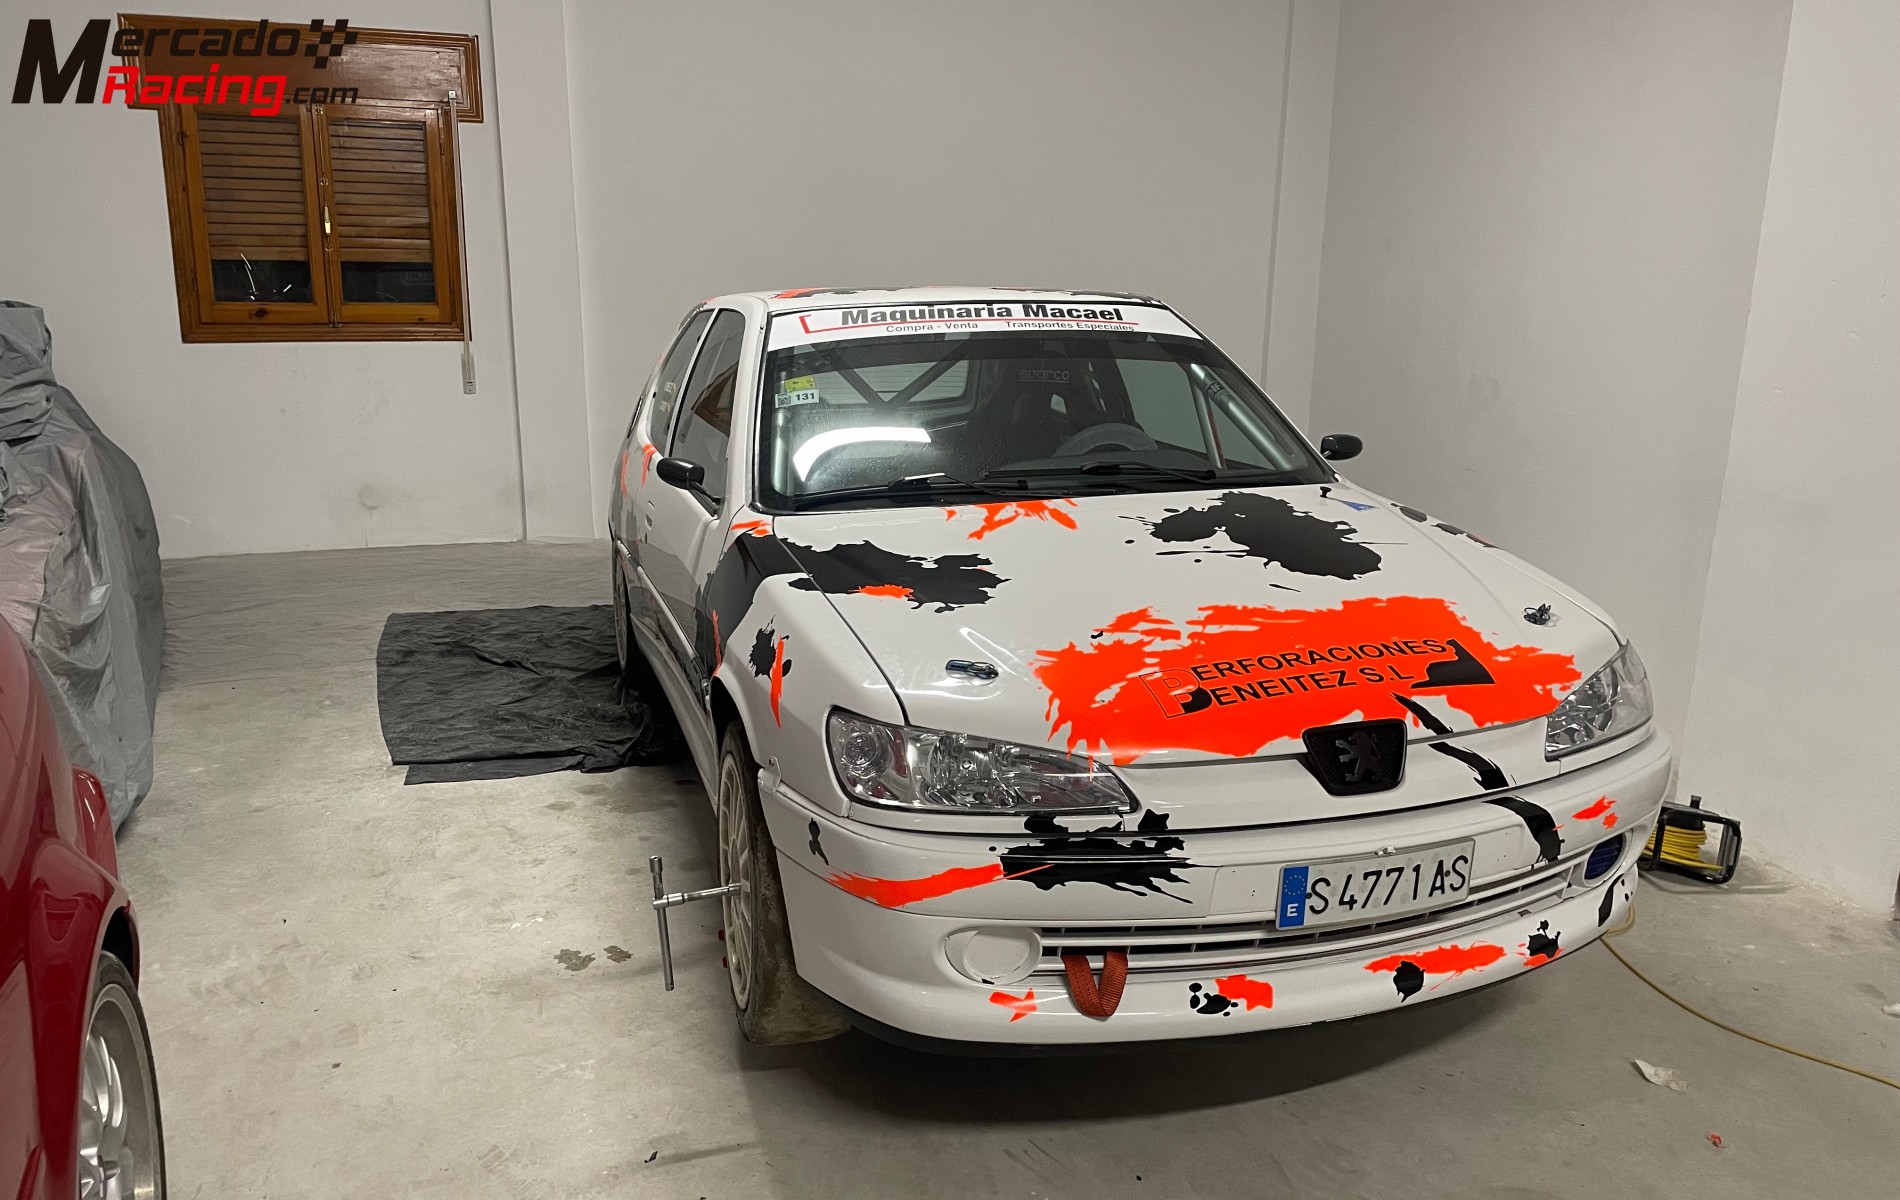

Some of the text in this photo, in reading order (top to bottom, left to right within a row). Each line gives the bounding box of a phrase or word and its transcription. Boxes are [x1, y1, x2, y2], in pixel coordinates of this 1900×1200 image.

[841, 303, 1123, 325] Maquinaria Macael
[886, 324, 933, 333] Compra
[945, 322, 978, 330] Venta
[1006, 321, 1135, 332] Transportes Especiales
[795, 392, 815, 401] 131
[1286, 903, 1298, 917] E
